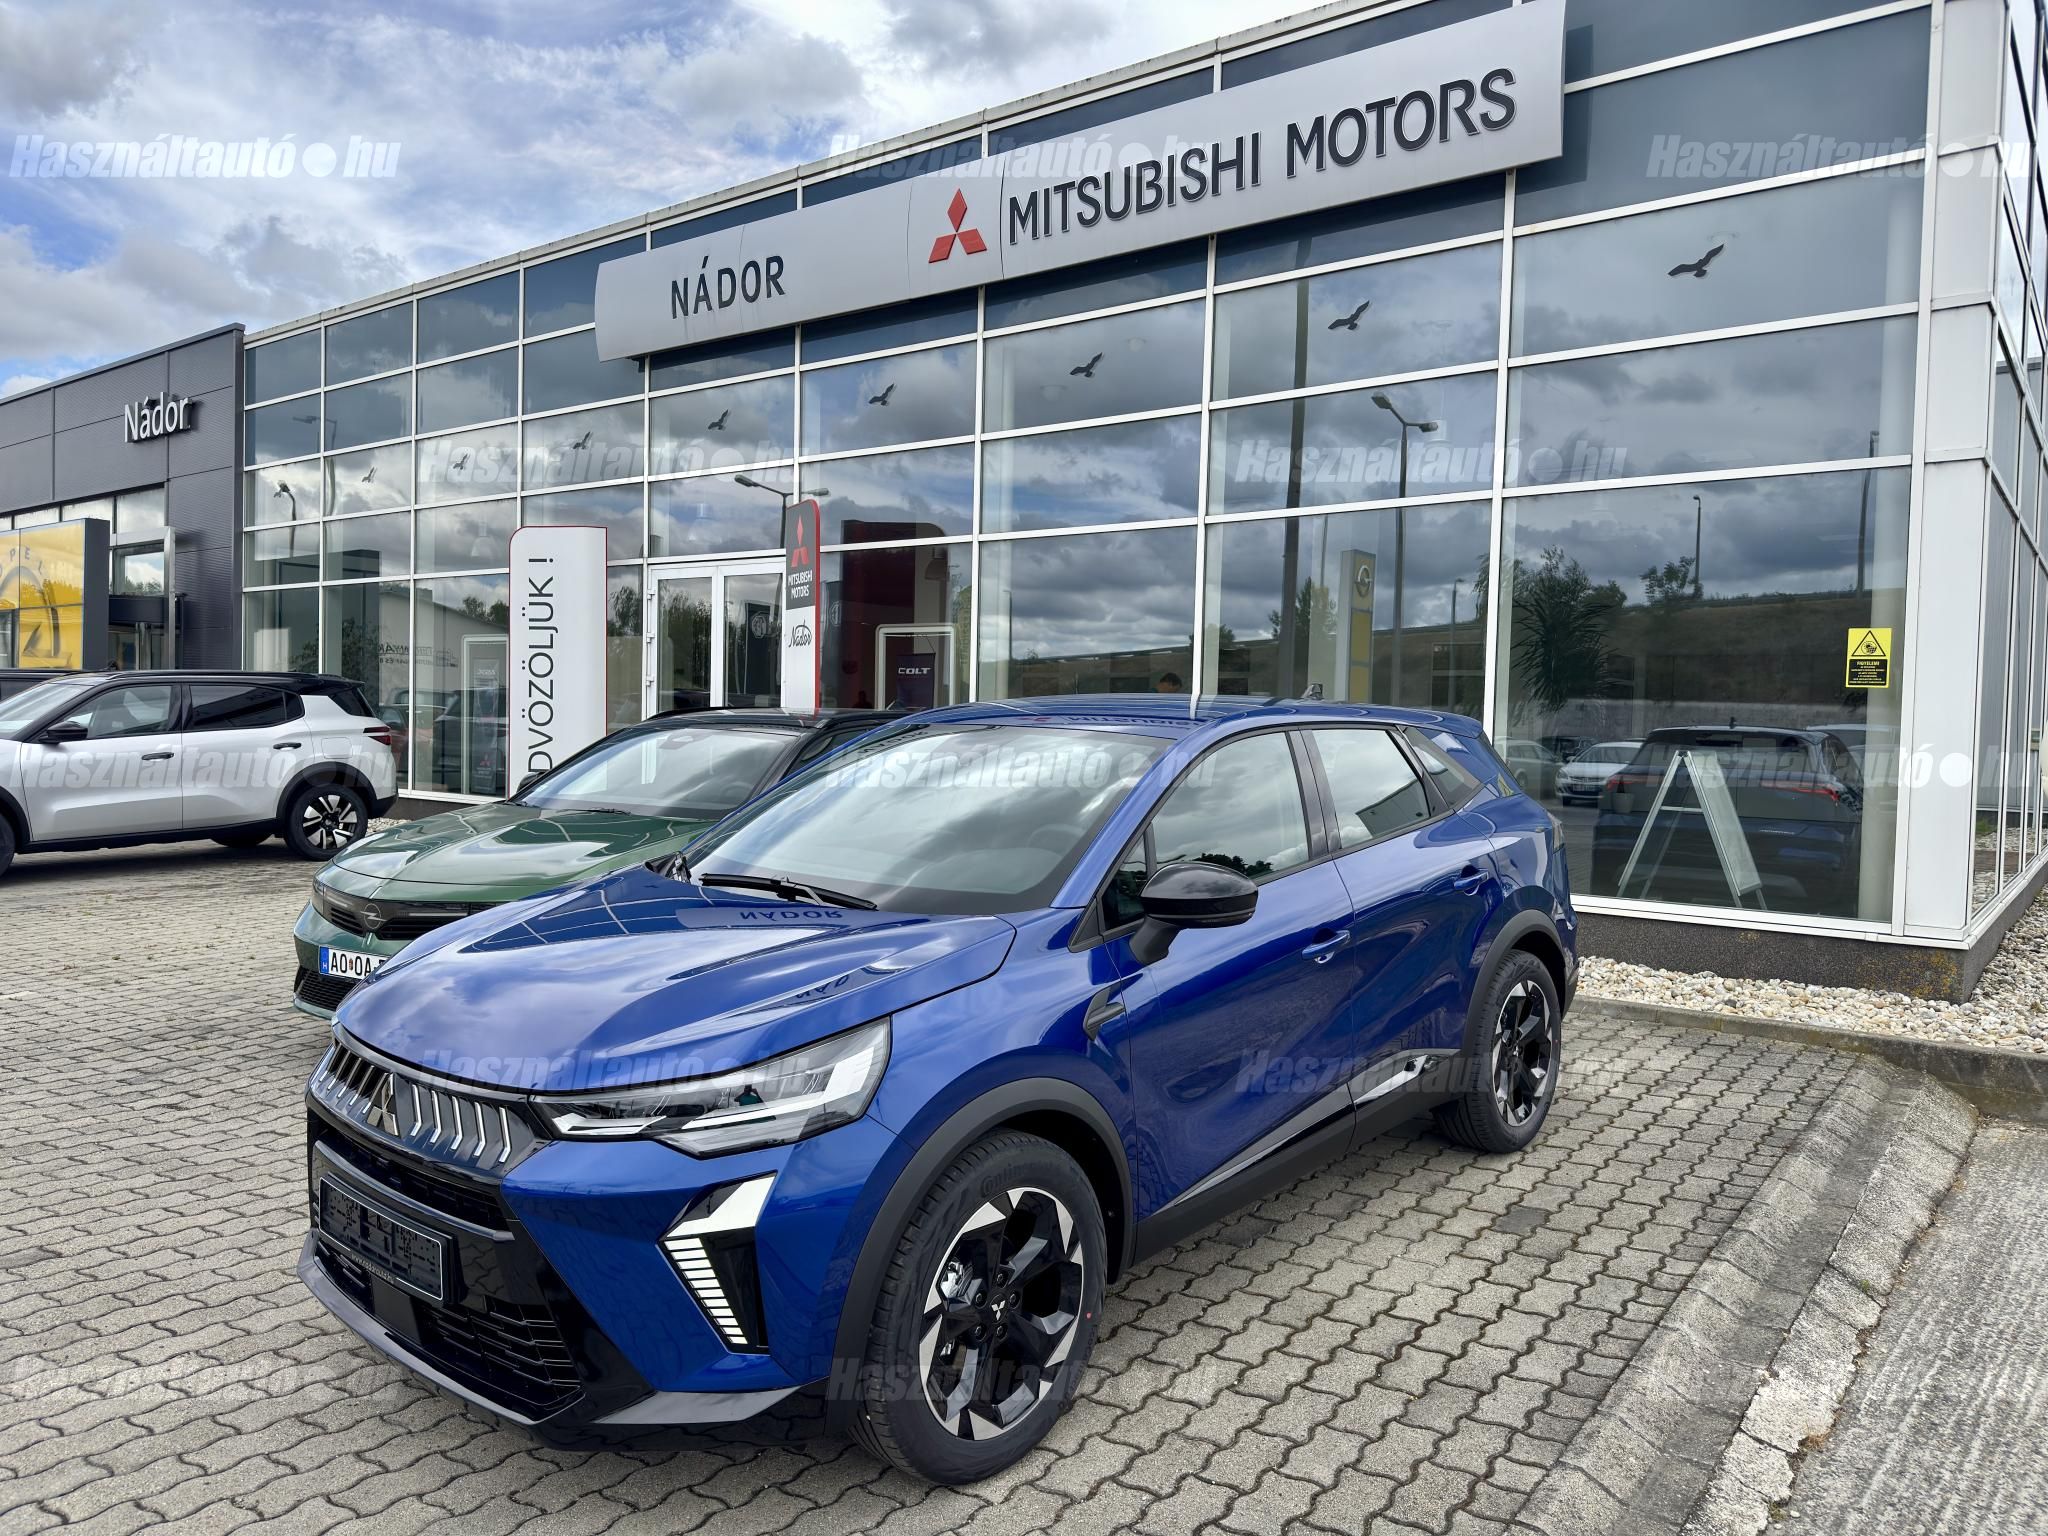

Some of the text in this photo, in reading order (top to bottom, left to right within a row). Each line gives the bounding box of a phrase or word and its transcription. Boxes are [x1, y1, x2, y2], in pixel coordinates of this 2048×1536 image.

[1008, 68, 1517, 245] MITSUBISHI MOTORS
[671, 255, 786, 319] NÁDOR
[124, 391, 190, 443] Nádor
[0, 547, 43, 577] PEL
[787, 570, 813, 587] MITSUBISHI
[790, 585, 810, 599] MOTORS
[522, 576, 559, 773] DVÖZÖLJÜK
[898, 667, 932, 675] COLT
